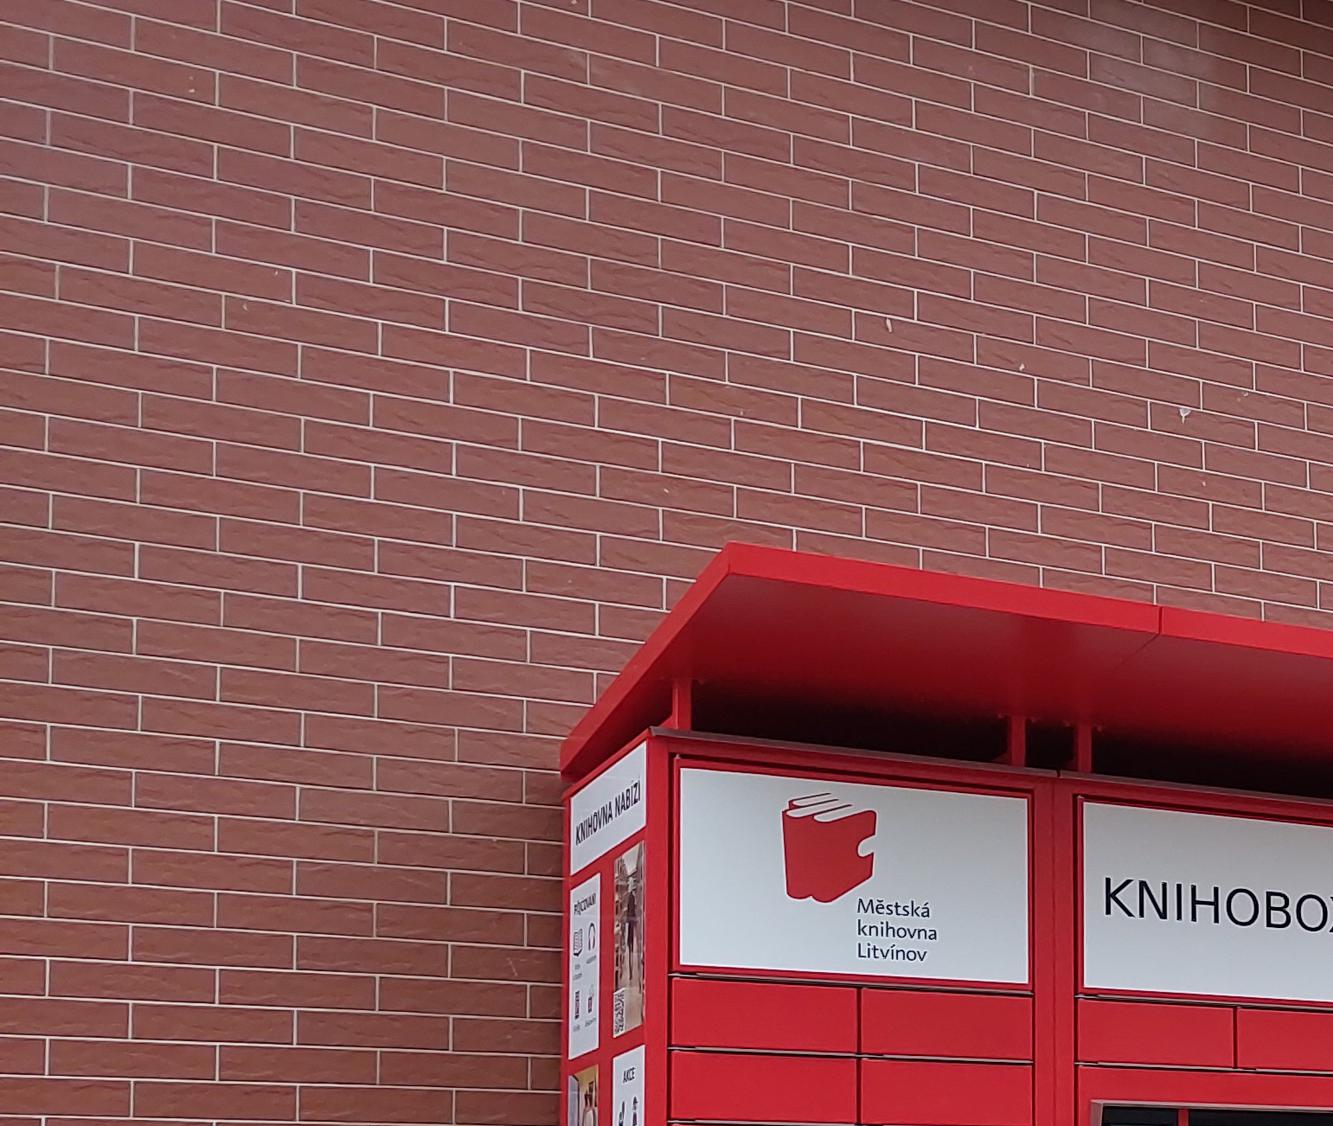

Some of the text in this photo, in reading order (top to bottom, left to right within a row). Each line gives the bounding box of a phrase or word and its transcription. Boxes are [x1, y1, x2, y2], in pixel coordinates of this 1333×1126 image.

[575, 801, 614, 846] KNIHOVNA
[857, 898, 930, 918] Městská
[857, 919, 938, 941] knihovna
[857, 942, 928, 962] Litvínov
